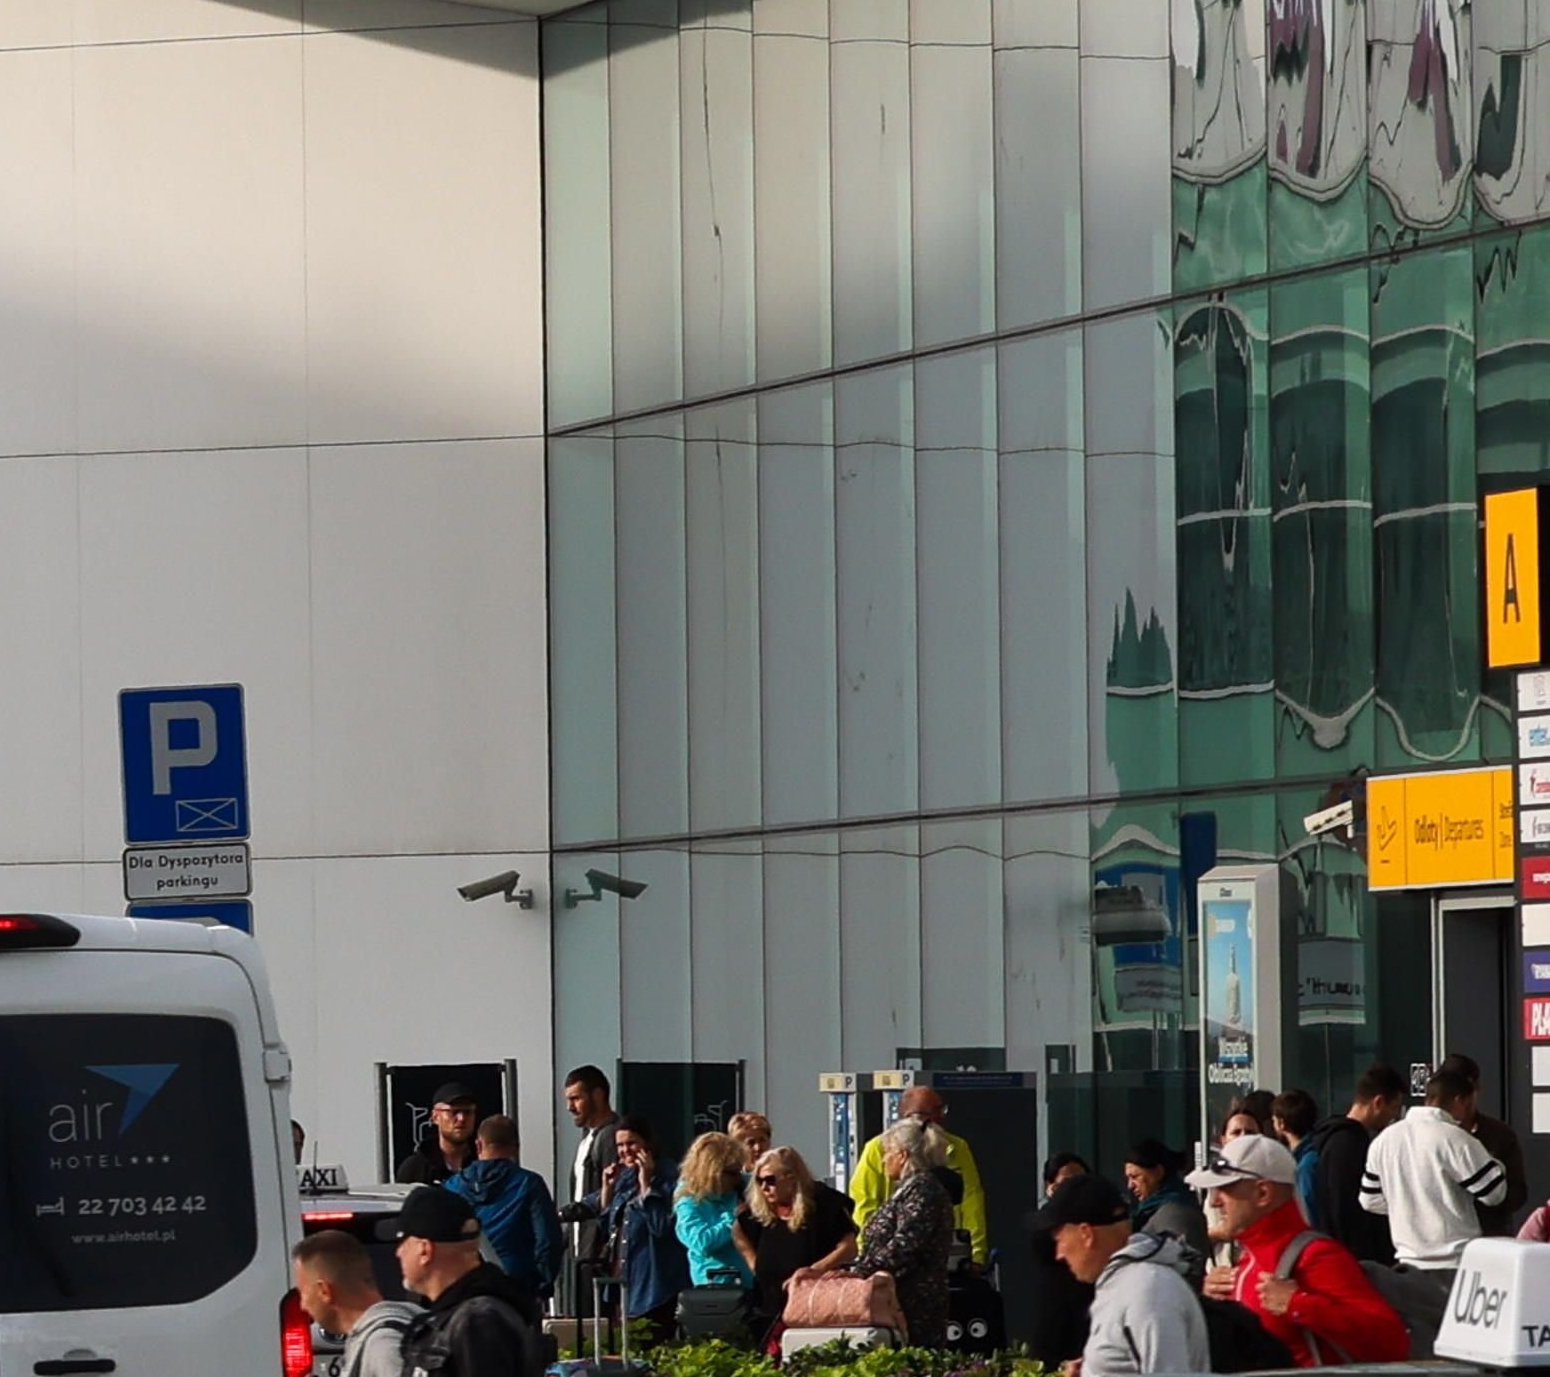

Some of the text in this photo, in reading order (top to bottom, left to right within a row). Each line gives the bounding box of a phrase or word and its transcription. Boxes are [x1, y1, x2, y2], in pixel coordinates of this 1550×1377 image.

[1502, 533, 1521, 624] A
[150, 700, 218, 795] P
[129, 854, 243, 871] Dla Dyspozytora
[156, 875, 219, 891] parkingu
[49, 1088, 113, 1143] air
[51, 1156, 123, 1169] HOTEL
[295, 1169, 338, 1187] AXI
[78, 1195, 207, 1217] 22 703 42 42
[71, 1229, 177, 1244] www.airhotel.pl
[1454, 1270, 1507, 1329] Uber
